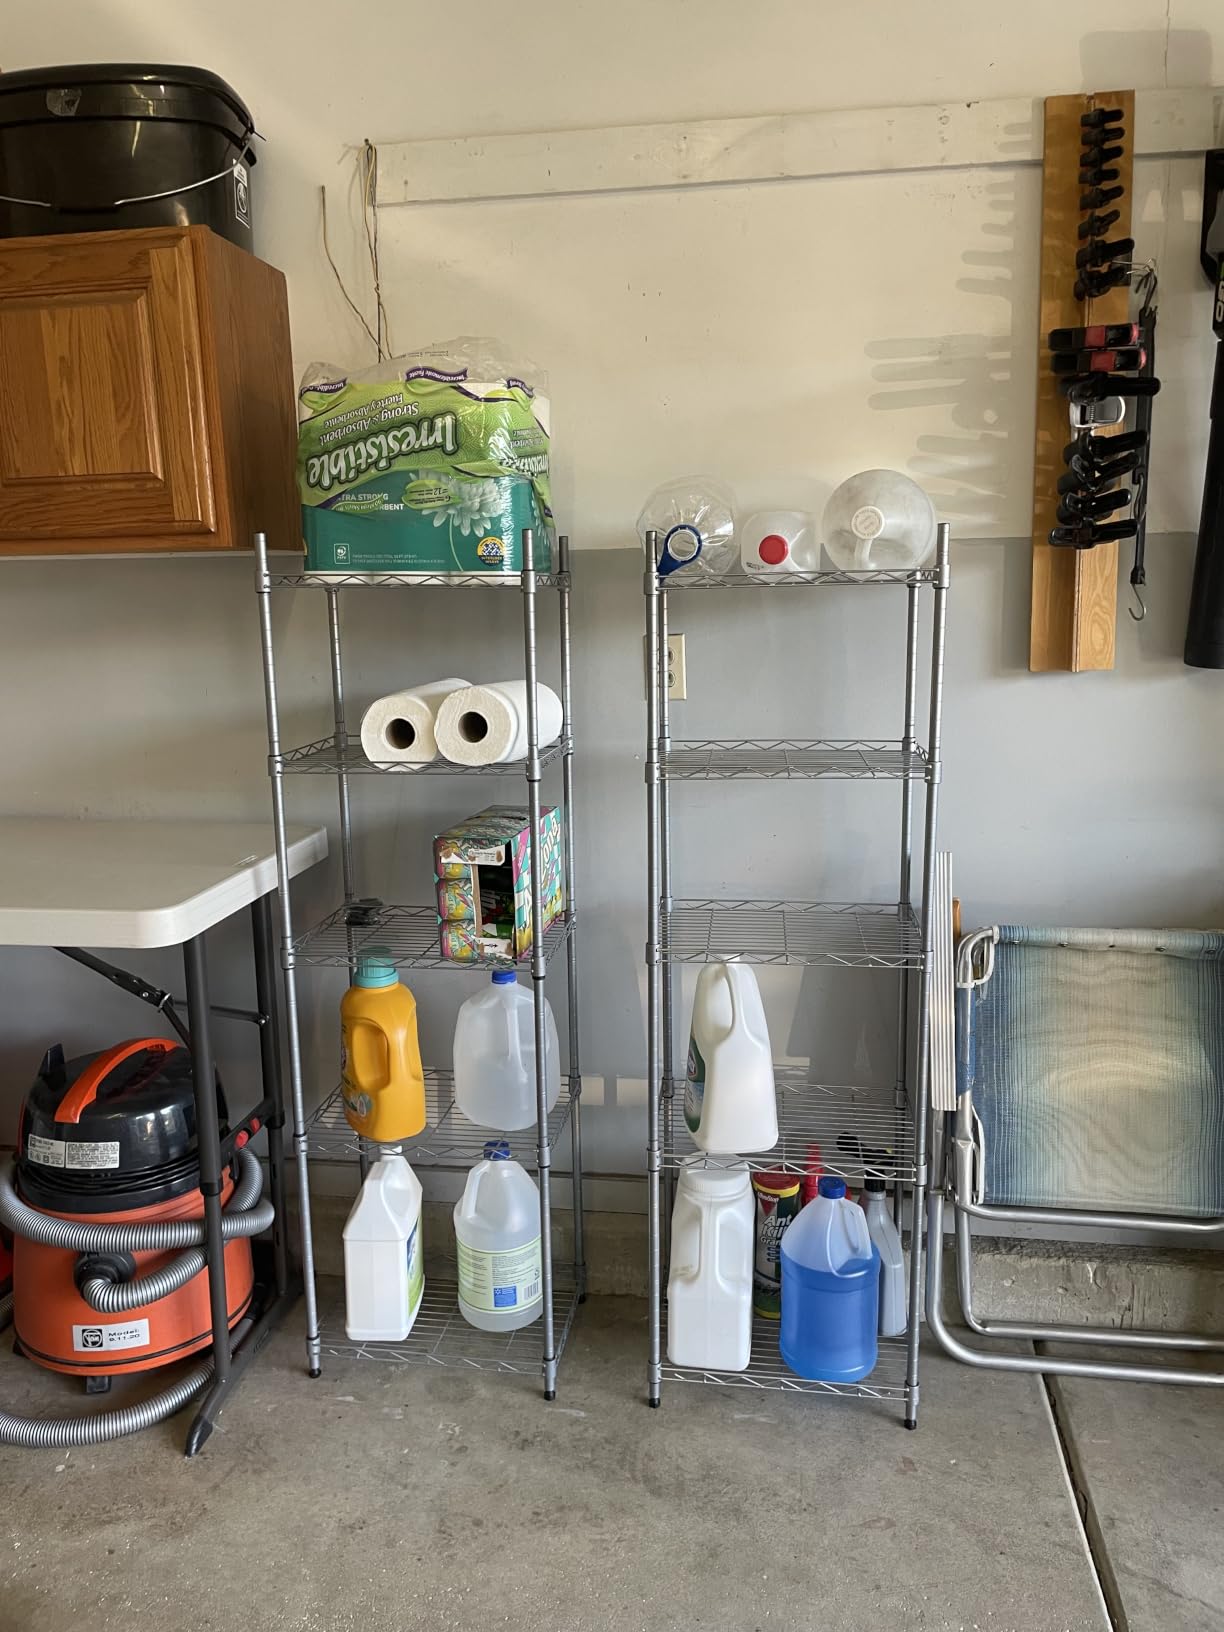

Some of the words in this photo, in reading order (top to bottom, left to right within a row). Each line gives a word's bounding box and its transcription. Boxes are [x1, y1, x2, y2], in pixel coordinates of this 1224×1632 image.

[376, 393, 404, 408] Fuerte
[324, 405, 370, 428] Absorbente
[380, 402, 419, 423] Strong
[319, 416, 371, 446] Absorbent
[307, 412, 458, 488] Irresistible
[763, 1214, 792, 1227] Ant
